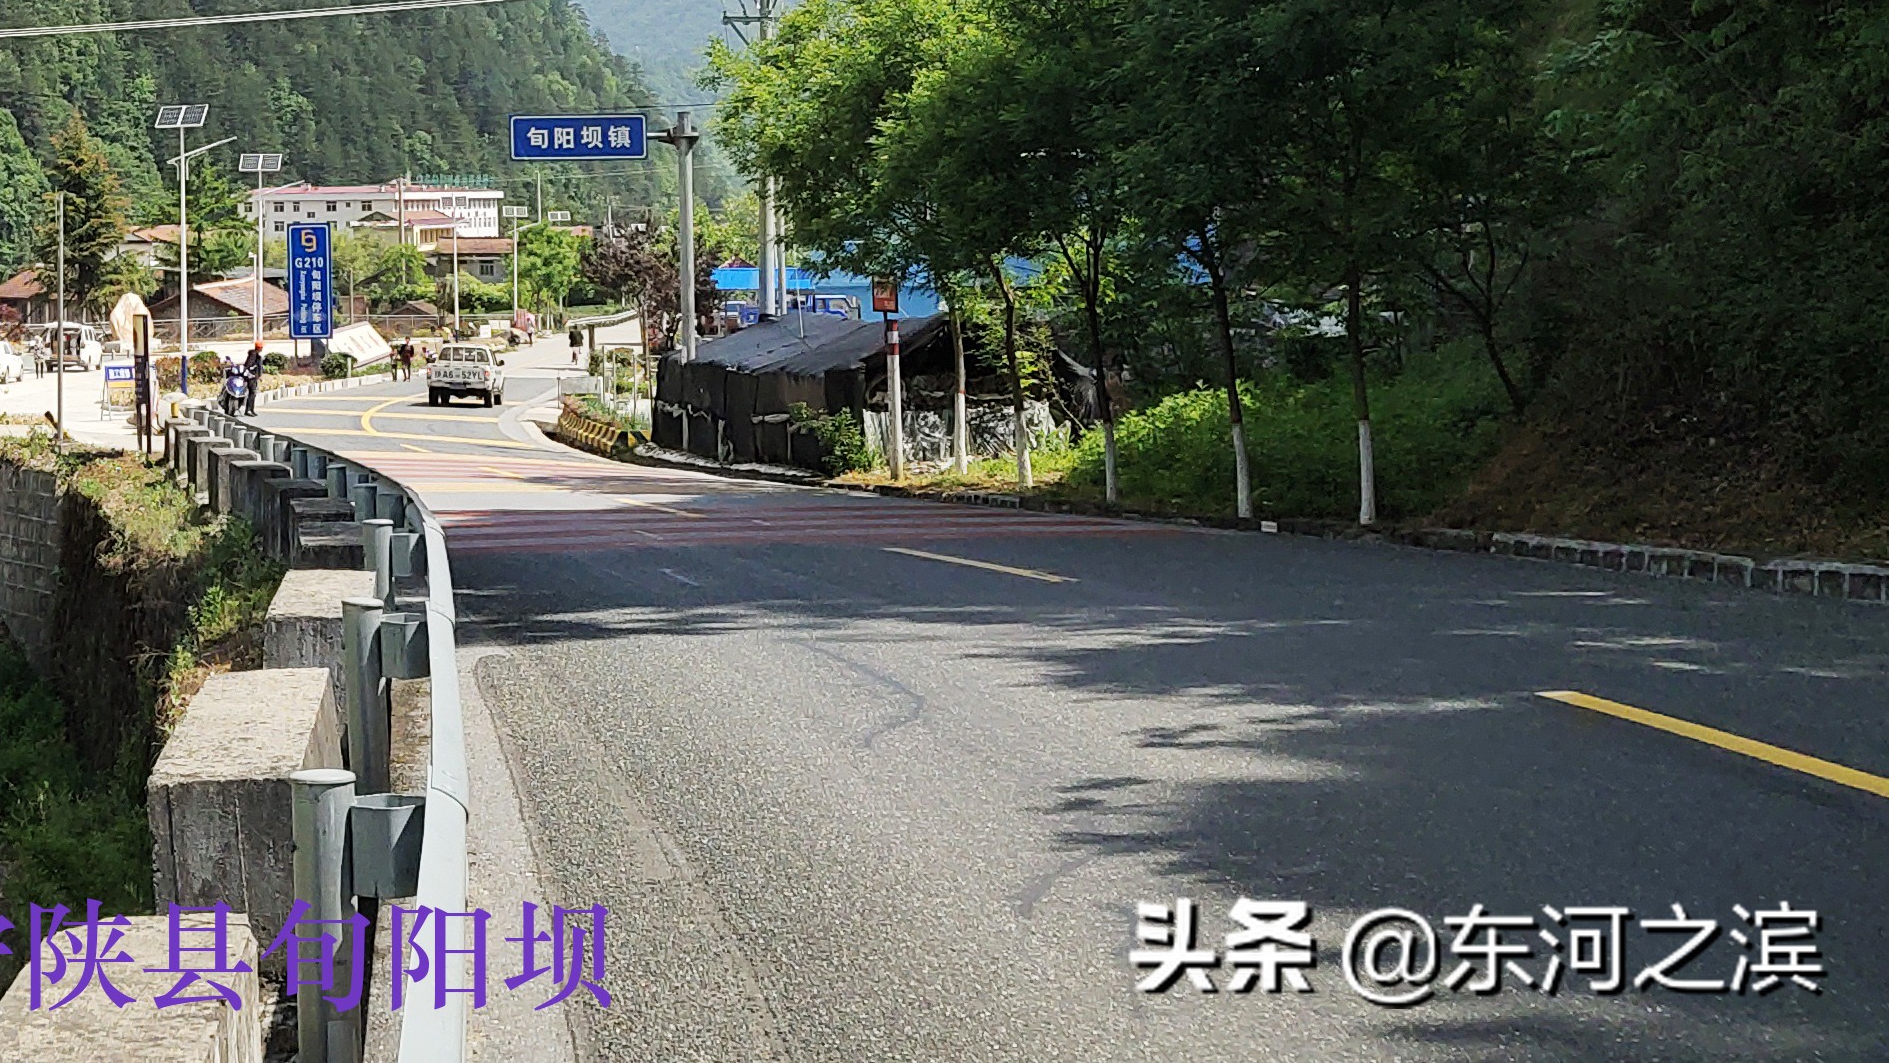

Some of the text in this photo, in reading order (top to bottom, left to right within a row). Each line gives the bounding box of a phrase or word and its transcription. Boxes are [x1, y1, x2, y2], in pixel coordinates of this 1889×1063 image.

[526, 125, 631, 149] 旬阳坝镇
[294, 257, 324, 269] G210
[311, 269, 323, 334] 旬阳坝停车区
